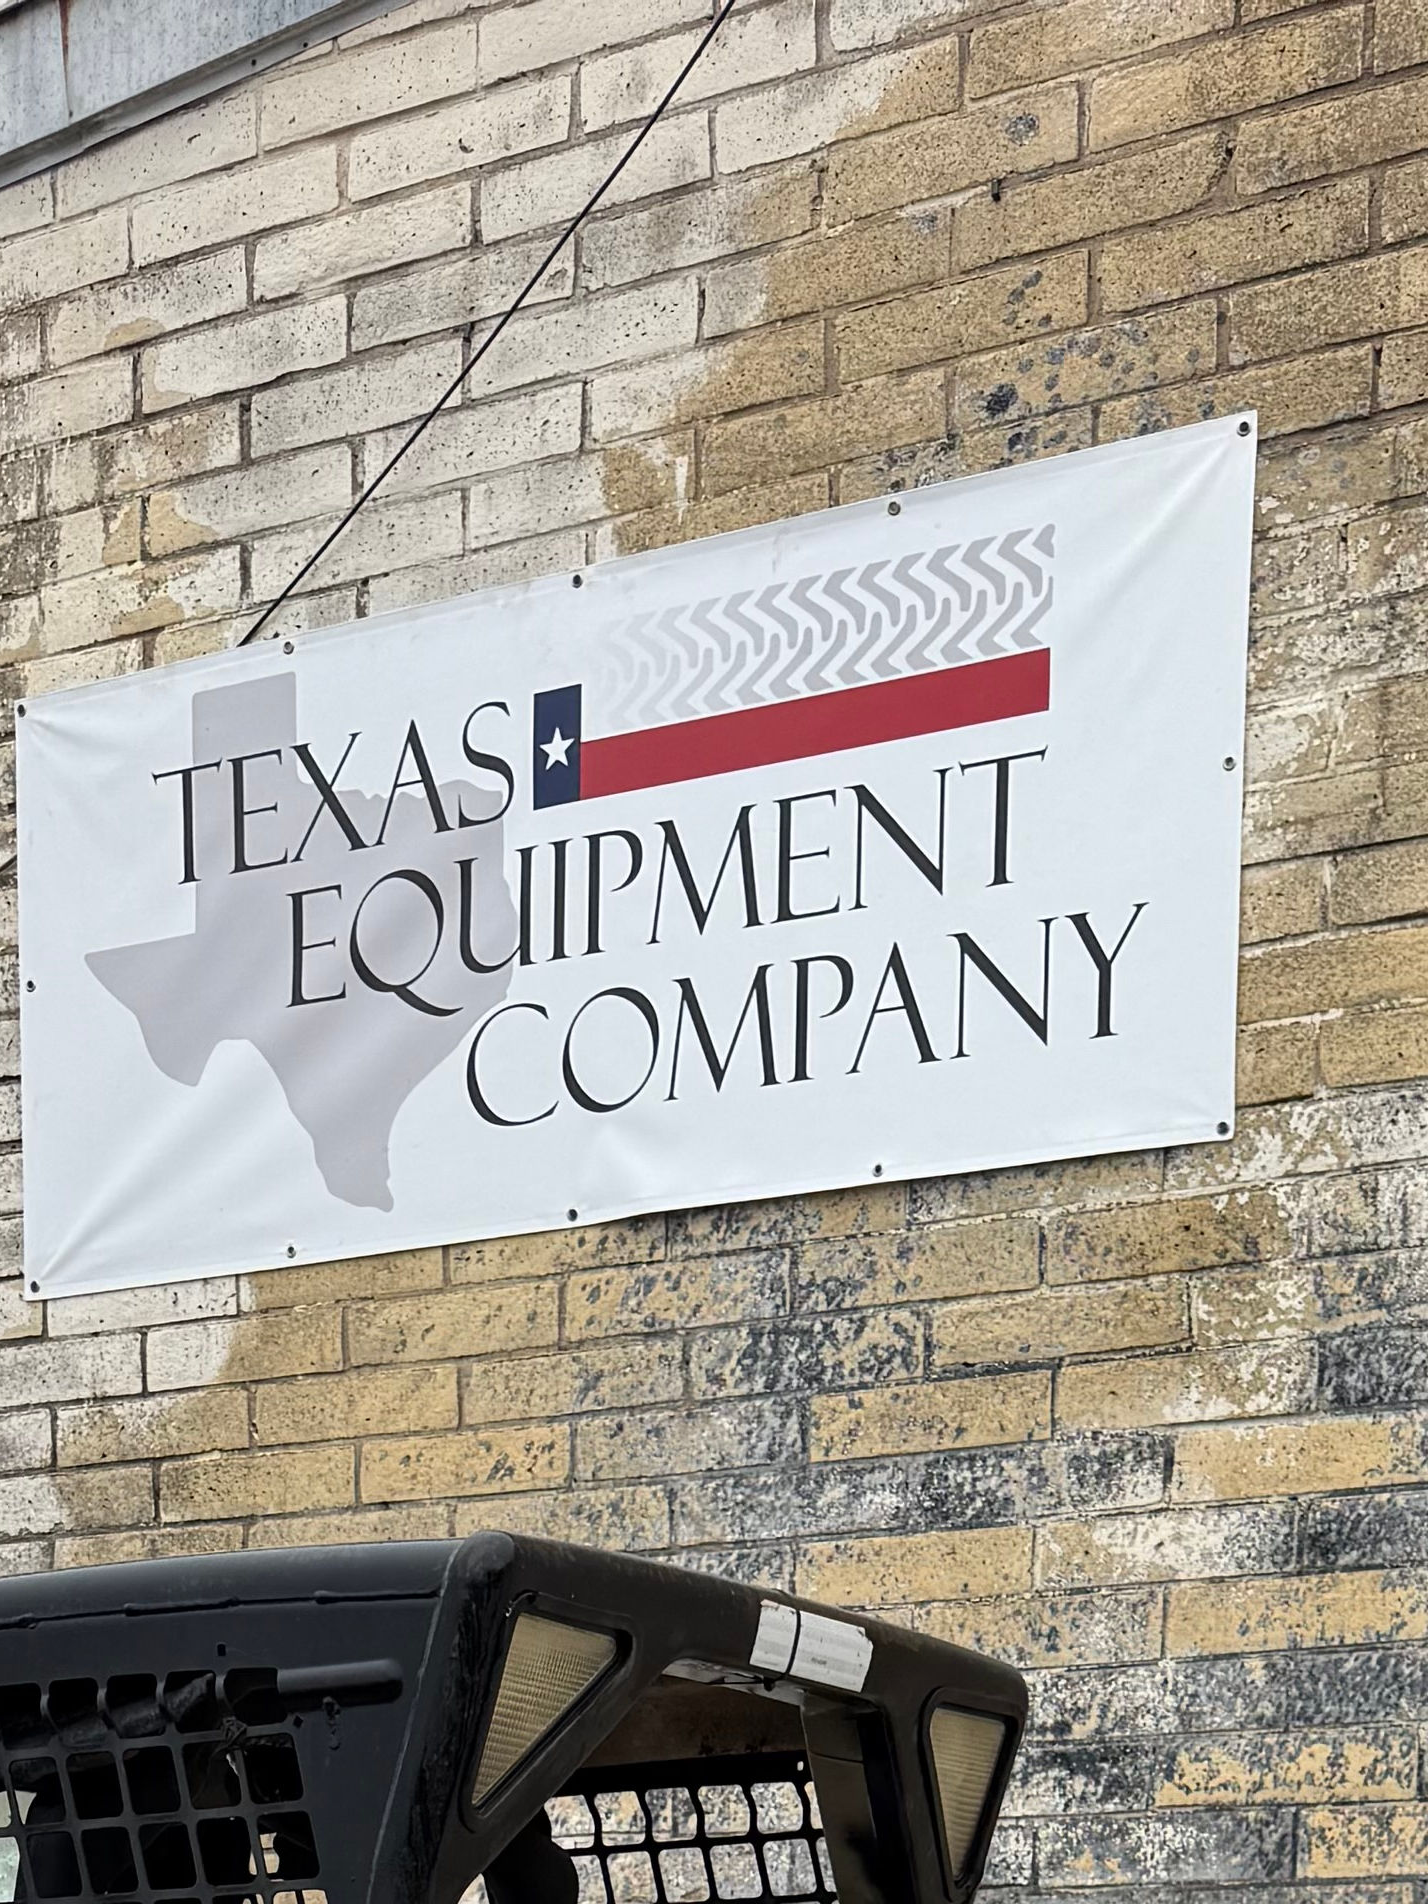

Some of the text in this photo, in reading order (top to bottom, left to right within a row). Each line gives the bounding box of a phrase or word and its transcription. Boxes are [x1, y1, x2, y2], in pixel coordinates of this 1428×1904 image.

[151, 702, 516, 886] TEXAS
[286, 746, 1049, 1018] EQUIPMENT
[466, 901, 1148, 1128] COMPANY
